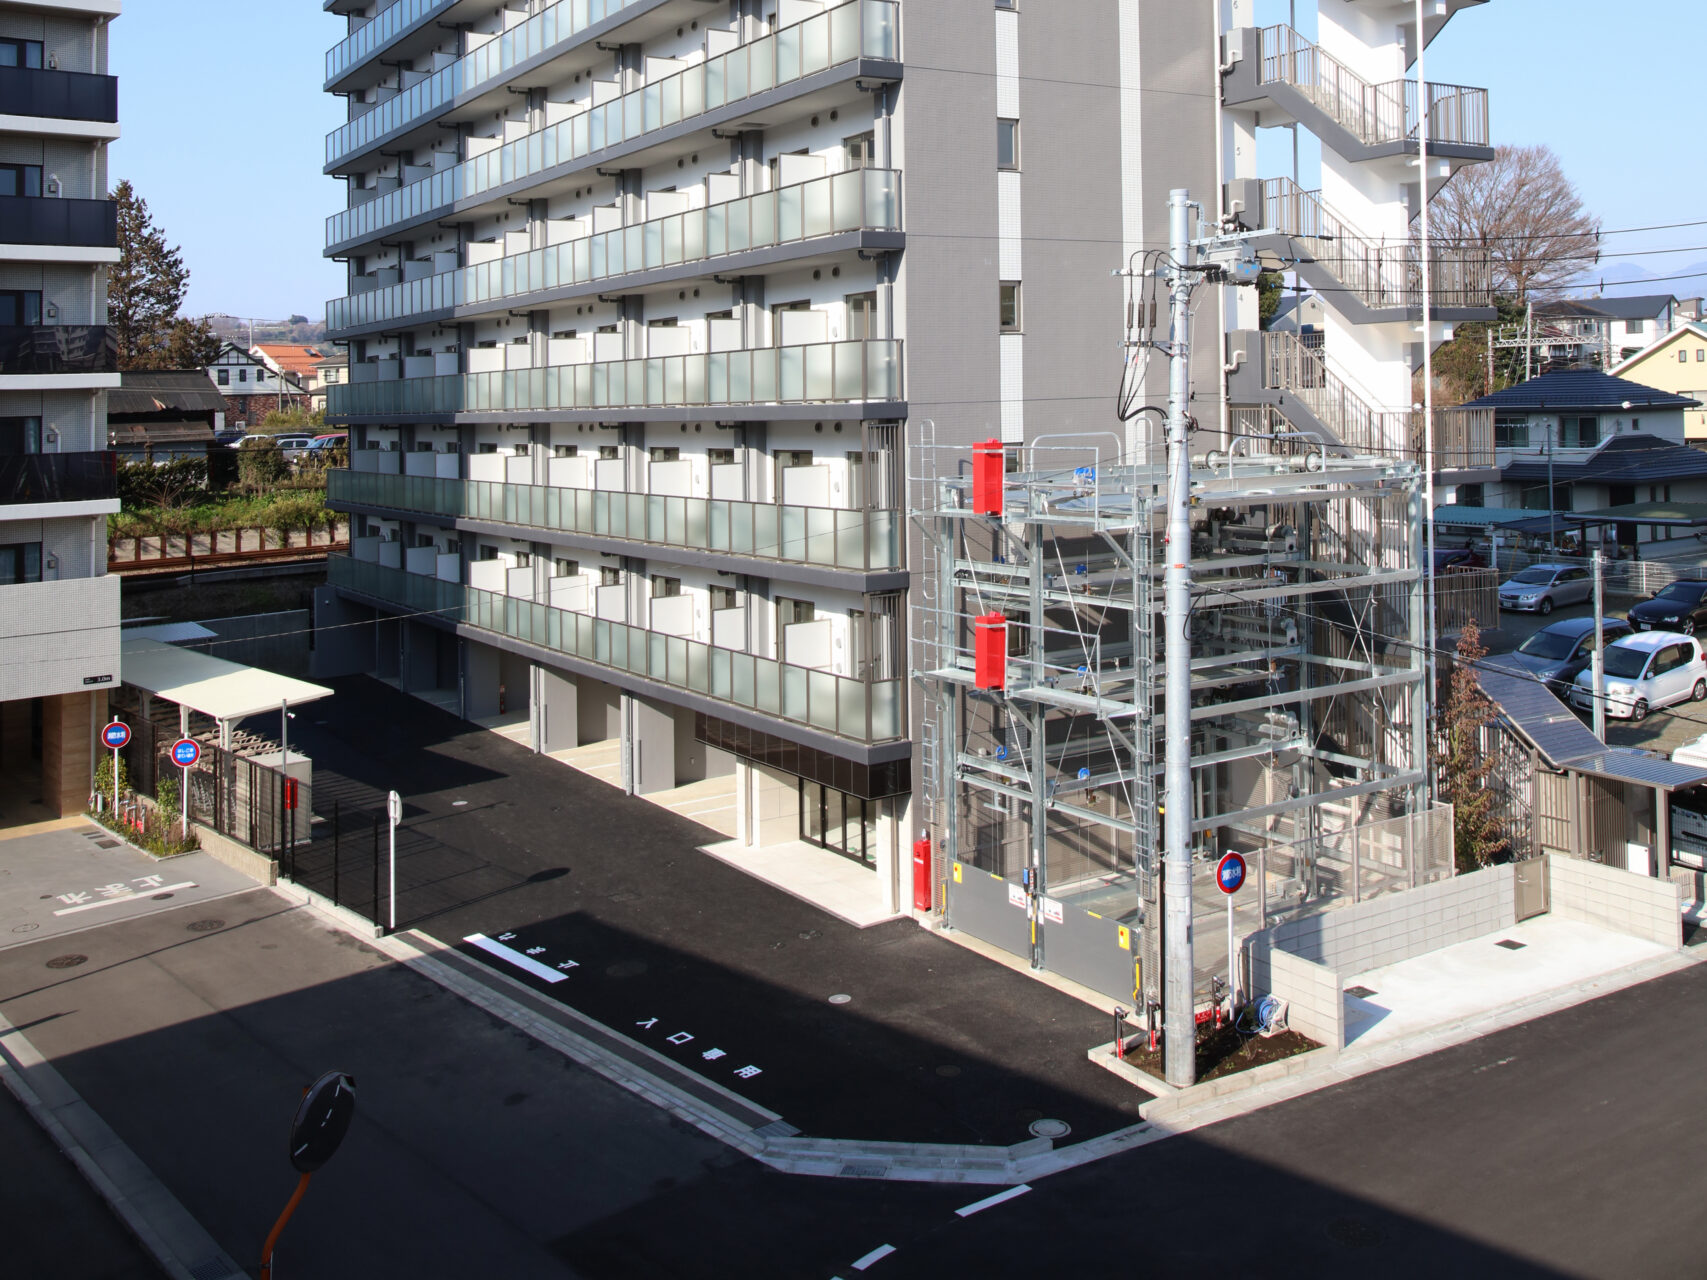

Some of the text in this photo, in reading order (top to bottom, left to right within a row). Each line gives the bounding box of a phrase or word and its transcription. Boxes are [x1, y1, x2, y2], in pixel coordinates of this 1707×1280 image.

[56, 874, 164, 904] 止まれ
[498, 932, 580, 969] 止まれ
[636, 1018, 763, 1078] 入口専用
